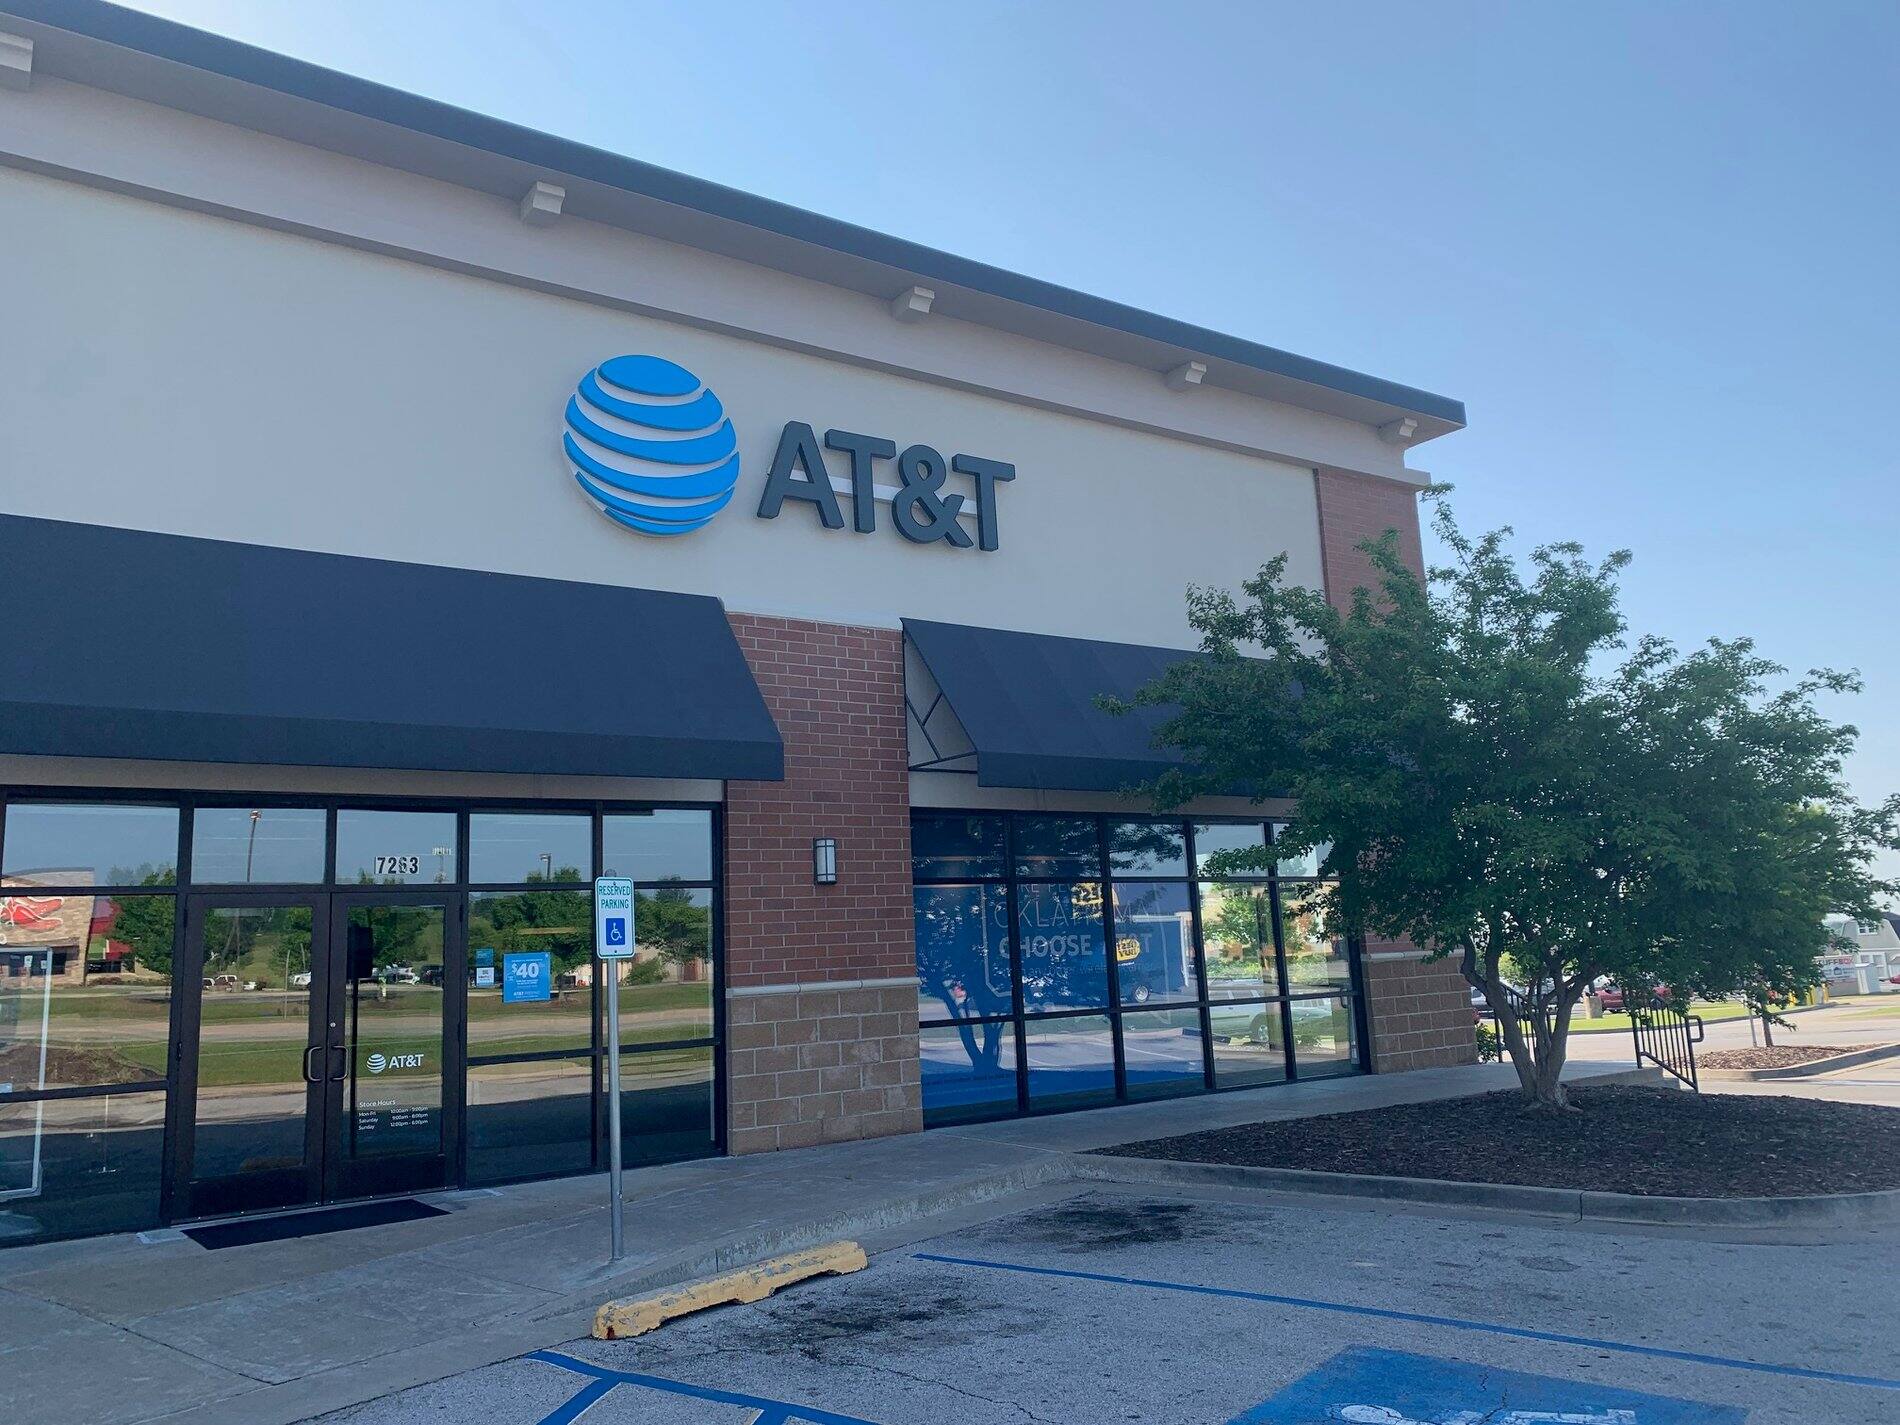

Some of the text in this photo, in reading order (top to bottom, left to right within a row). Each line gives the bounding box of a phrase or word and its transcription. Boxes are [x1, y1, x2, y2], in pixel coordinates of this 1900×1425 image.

[757, 420, 1016, 552] AT&T
[377, 856, 419, 875] 7263
[599, 886, 631, 896] RESERVED
[601, 899, 630, 909] PARKING
[999, 934, 1092, 959] CHOOSE
[511, 962, 540, 979] $40
[388, 1053, 425, 1069] AT&T
